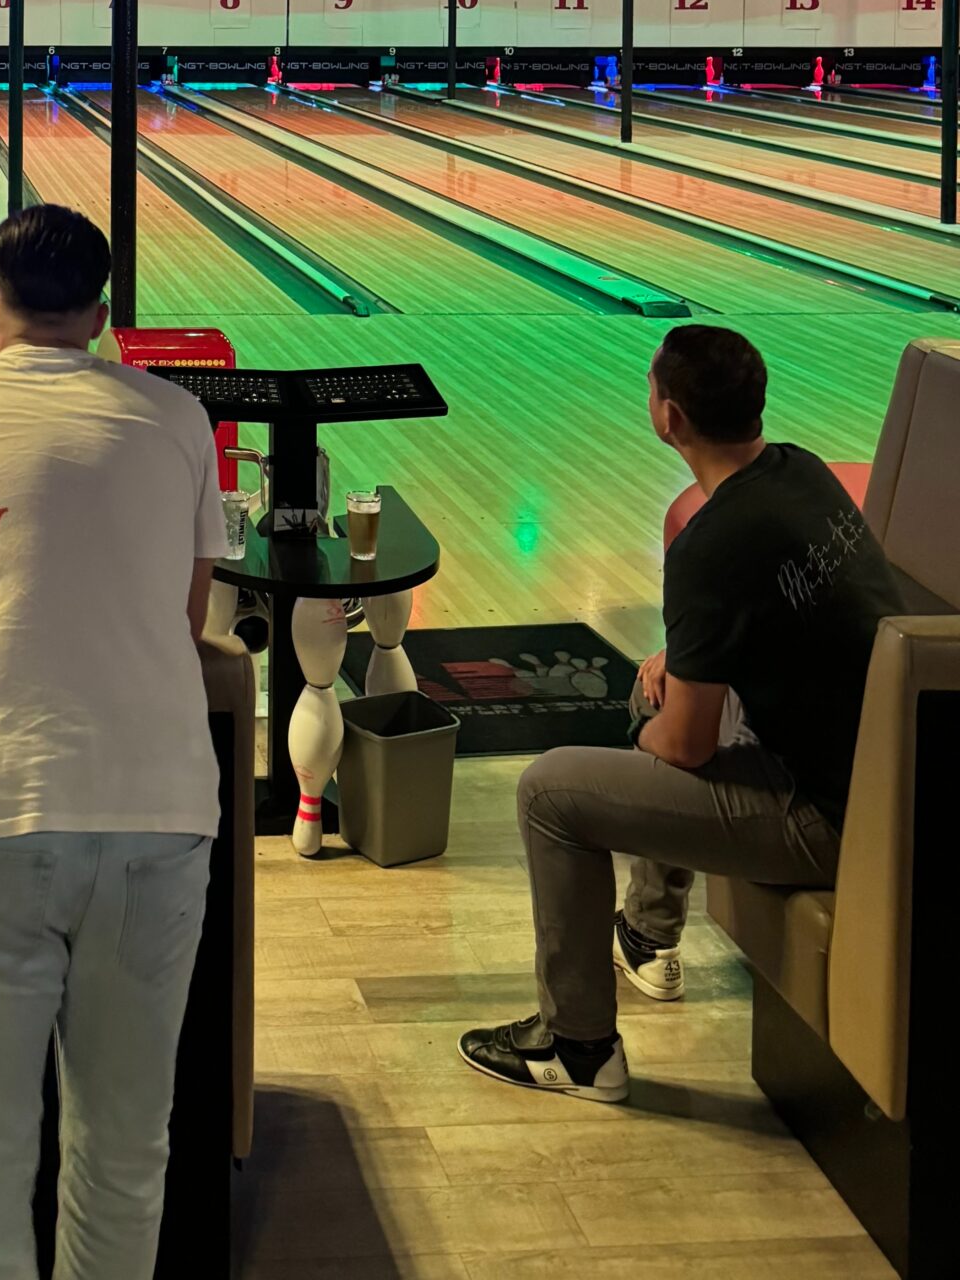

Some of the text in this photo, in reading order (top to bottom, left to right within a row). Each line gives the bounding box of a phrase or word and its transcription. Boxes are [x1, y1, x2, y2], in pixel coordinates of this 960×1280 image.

[48, 46, 55, 55] 6
[161, 47, 168, 55] 7
[274, 47, 281, 55] 8
[389, 48, 396, 56] 9
[504, 47, 514, 56] 10
[732, 48, 743, 57] 12
[843, 48, 855, 57] 13
[664, 959, 681, 973] 43
